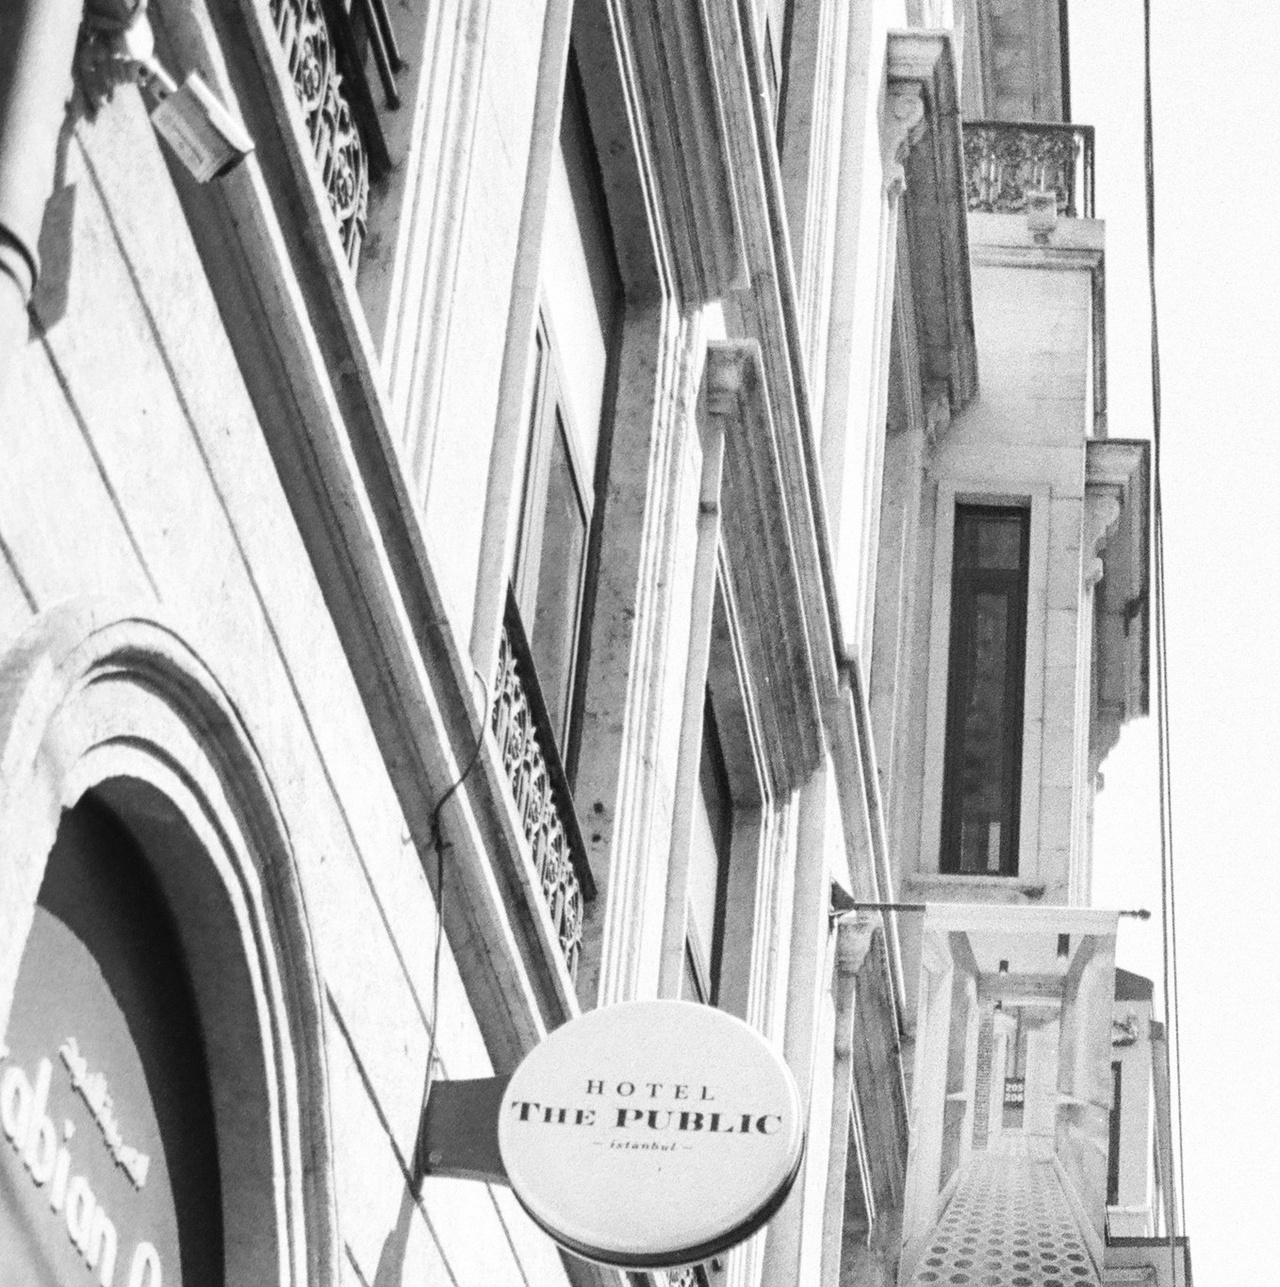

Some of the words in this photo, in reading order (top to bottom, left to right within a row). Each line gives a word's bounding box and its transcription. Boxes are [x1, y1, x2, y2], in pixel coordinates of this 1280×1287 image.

[586, 1079, 720, 1101] HOTEL
[511, 1101, 597, 1126] THE
[615, 1107, 782, 1136] PUBLIC
[609, 1138, 677, 1151] istanbul
